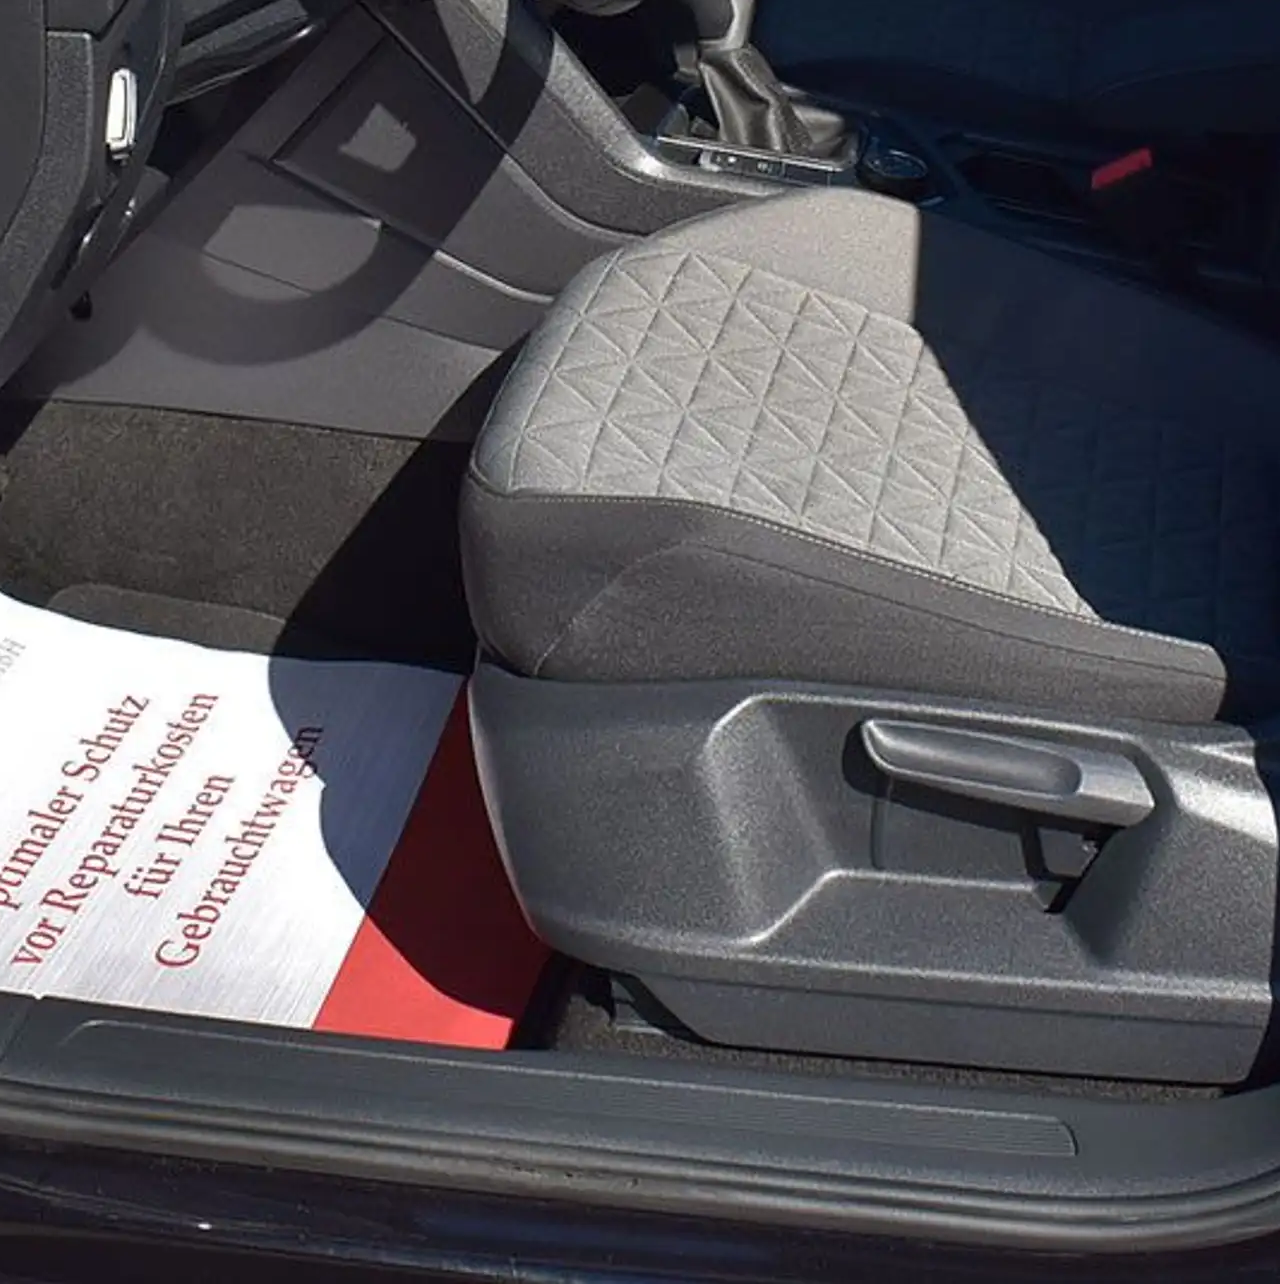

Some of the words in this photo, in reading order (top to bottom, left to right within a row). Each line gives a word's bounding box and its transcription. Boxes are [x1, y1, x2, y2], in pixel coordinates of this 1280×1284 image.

[11, 918, 67, 967] vor
[39, 693, 220, 915] Reparaturkosten
[61, 694, 150, 783] Schutz
[122, 855, 183, 899] für
[155, 773, 238, 848] Ihren
[154, 725, 324, 968] Gebrauchtwagen
